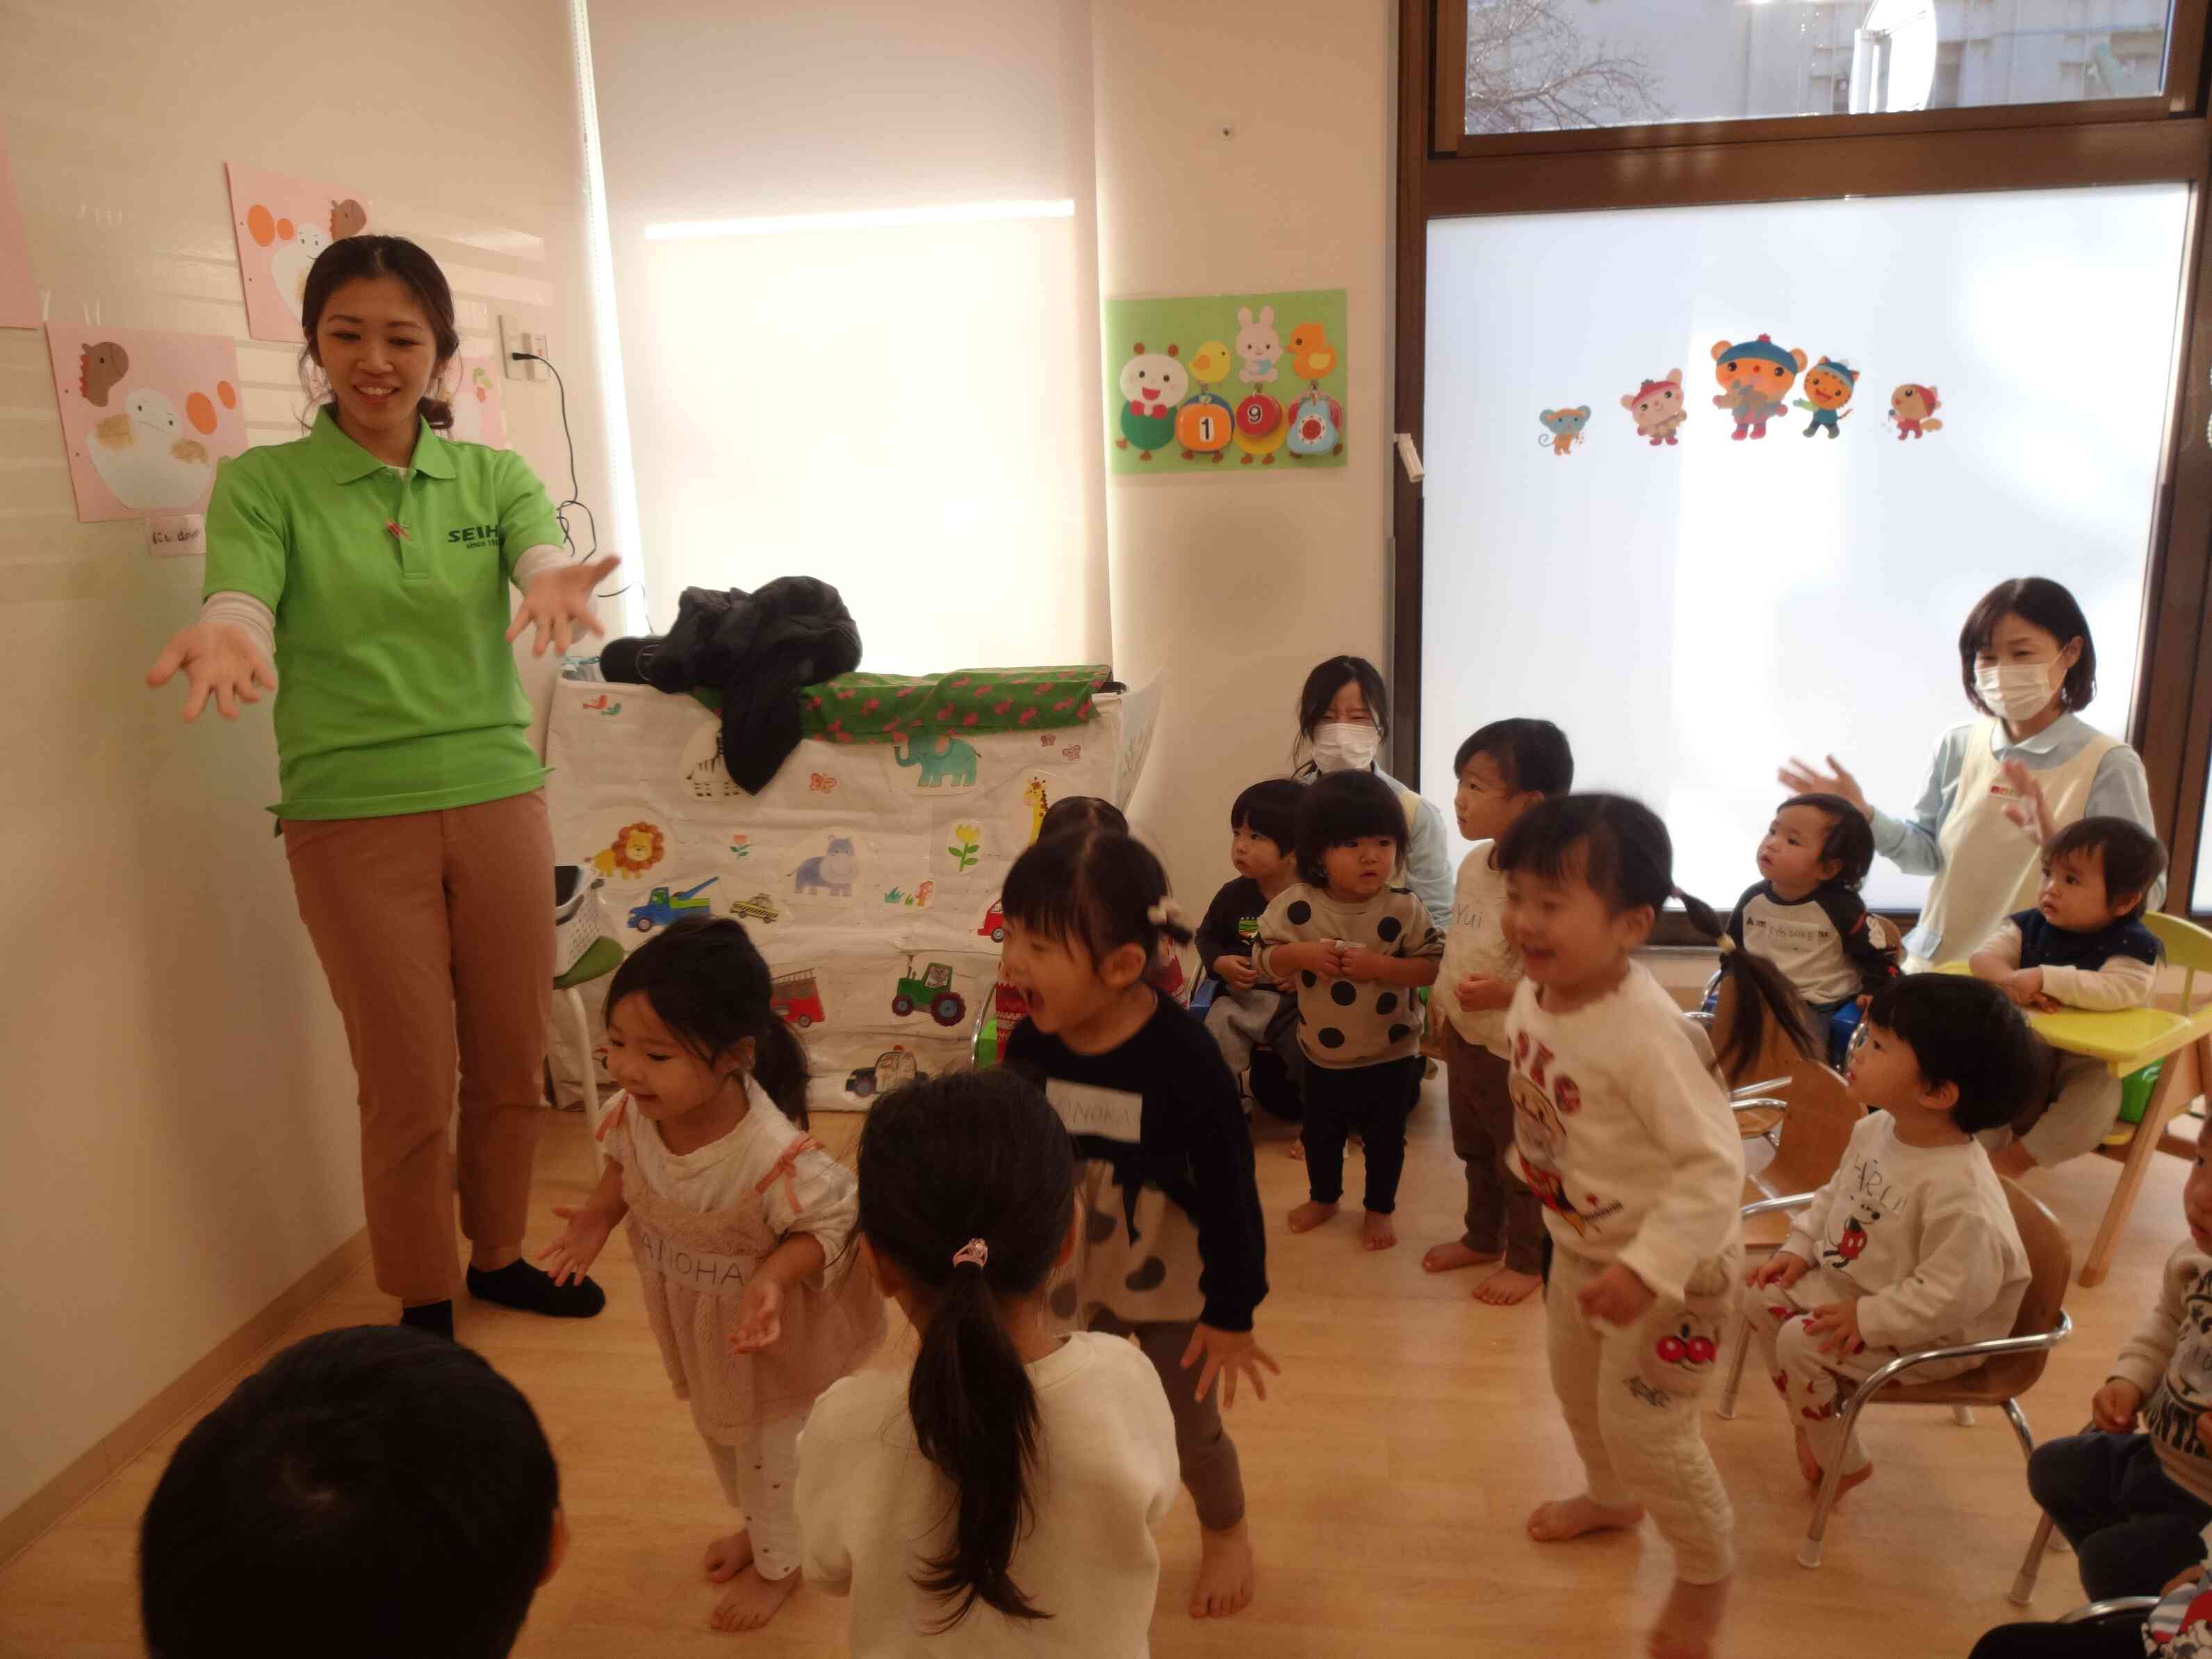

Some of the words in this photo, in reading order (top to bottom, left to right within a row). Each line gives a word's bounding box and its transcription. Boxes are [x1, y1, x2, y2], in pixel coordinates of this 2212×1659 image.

[1249, 406, 1261, 423] 9
[1201, 418, 1212, 440] 1
[448, 525, 500, 543] SEIH
